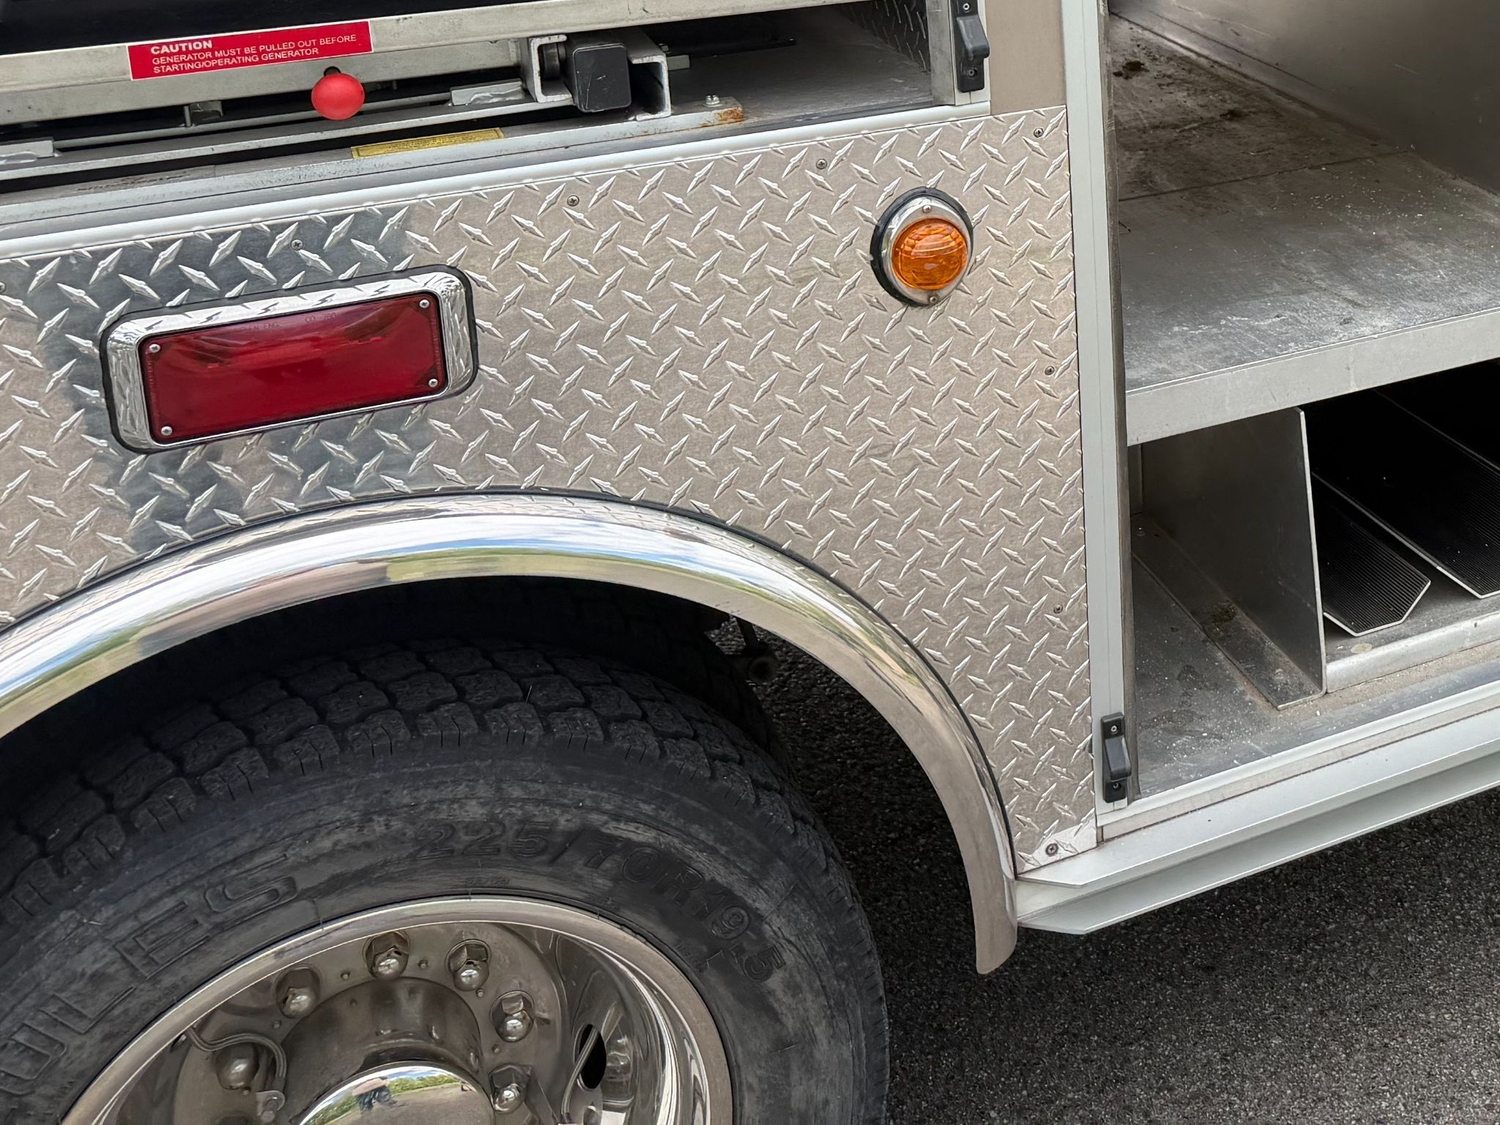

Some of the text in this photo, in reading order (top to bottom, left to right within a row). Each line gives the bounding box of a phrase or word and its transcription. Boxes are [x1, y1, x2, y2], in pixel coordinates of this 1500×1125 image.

[150, 40, 213, 55] CAUTION
[152, 34, 357, 65] GENERATOR MUST BE PULLED OUT BEFORE
[153, 47, 319, 74] STARTING/OPERATING GENERATOR
[412, 820, 785, 984] 225/70R19.5
